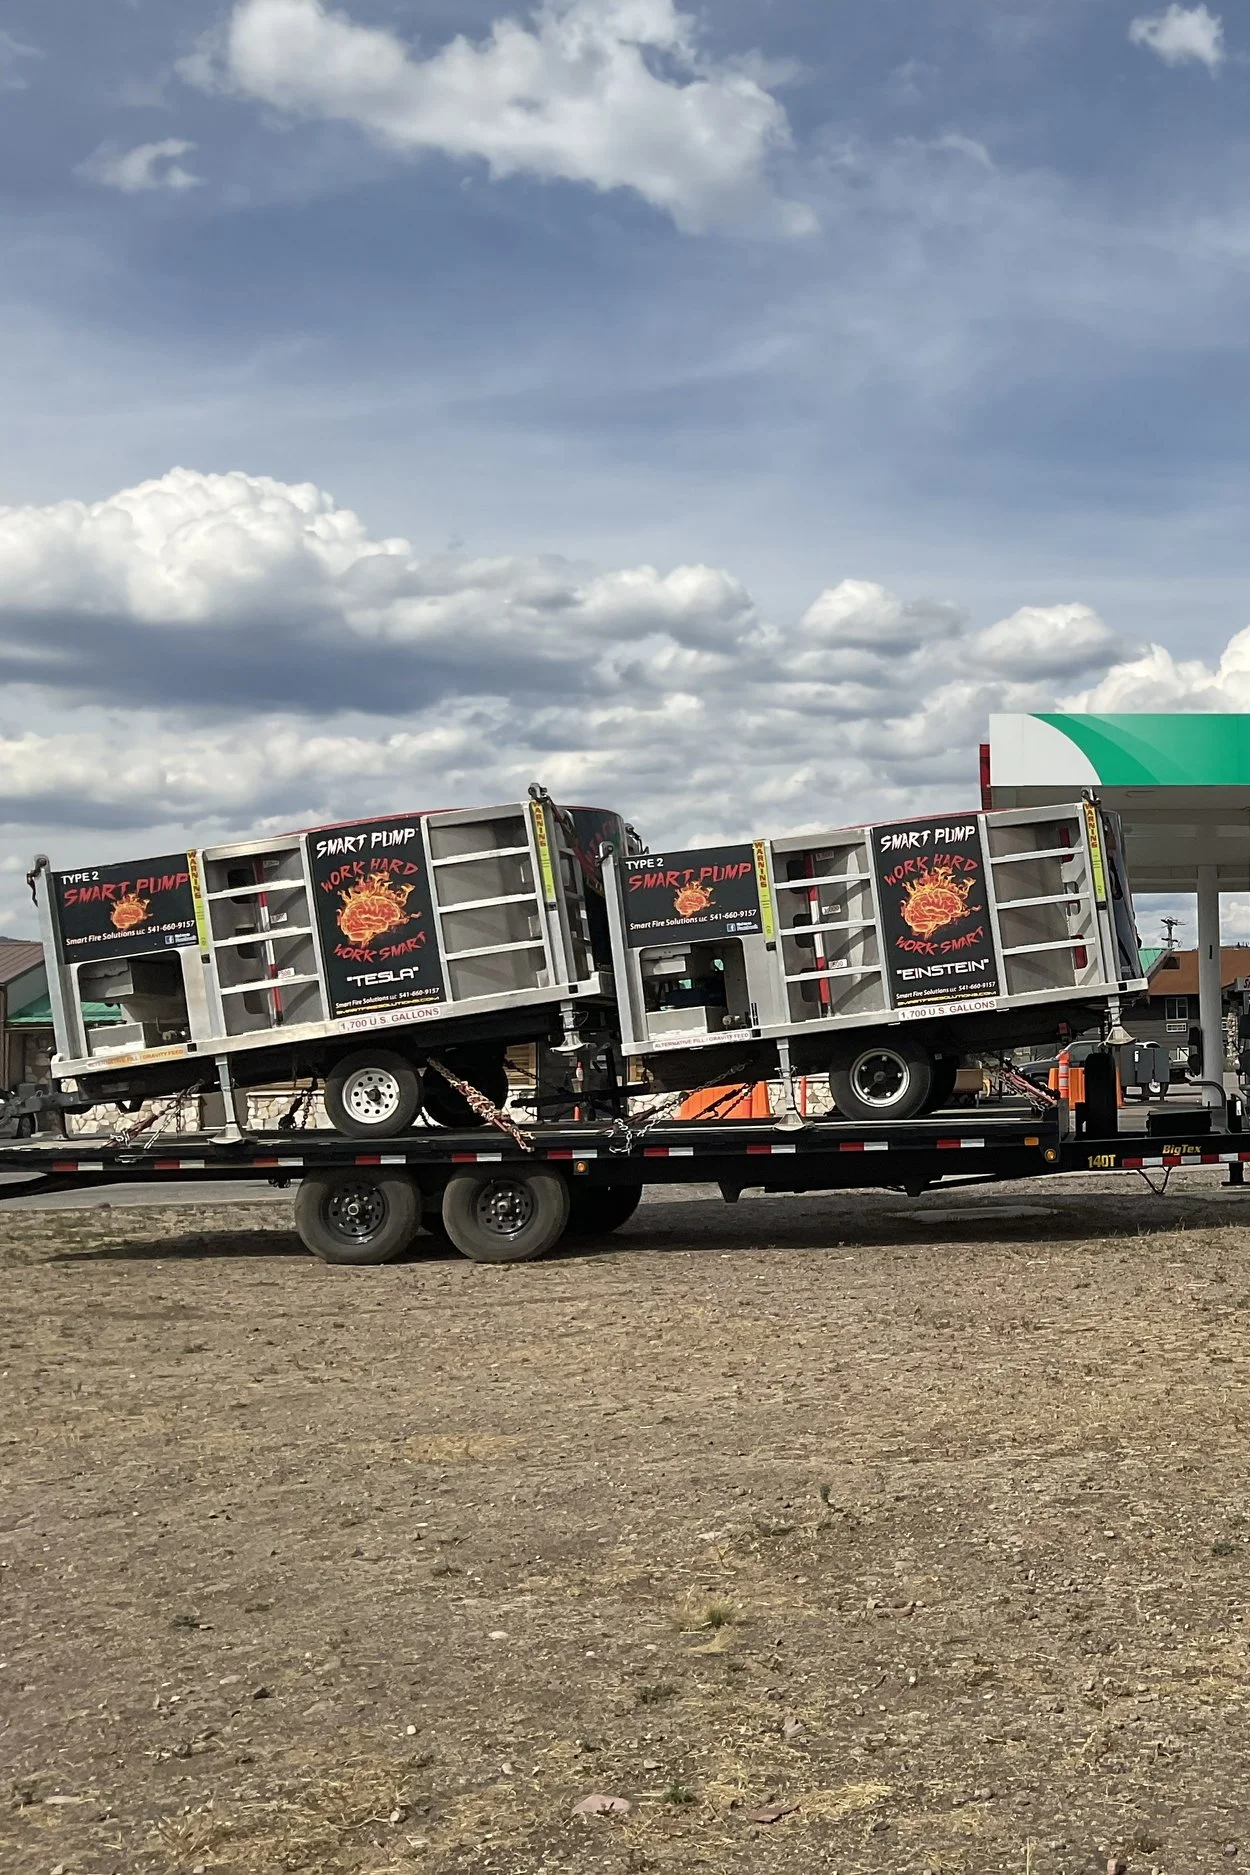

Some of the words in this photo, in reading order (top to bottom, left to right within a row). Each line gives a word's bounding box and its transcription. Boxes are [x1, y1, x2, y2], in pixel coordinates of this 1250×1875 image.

[880, 830, 931, 853] SMART
[934, 825, 976, 844] PUMP
[1084, 803, 1098, 848] WARNING
[316, 834, 367, 859] SMART
[371, 828, 415, 848] PUMP
[61, 872, 90, 885] TYPE
[91, 871, 99, 880] 2
[187, 850, 202, 899] WARNING
[321, 861, 365, 893] WORK
[370, 858, 418, 875] HARD
[625, 859, 655, 870] TYPE
[656, 858, 664, 867] 2
[628, 869, 695, 893] SMART
[699, 862, 752, 884] PUMP
[754, 842, 768, 888] WARNING
[884, 856, 928, 886] WORK
[933, 853, 978, 872] HARD
[64, 881, 131, 908] SMART
[136, 872, 190, 895] PUMP
[66, 936, 87, 946] Smart
[88, 934, 102, 943] Fire
[102, 929, 135, 941] Solutions
[147, 920, 195, 934] 541-660-9157
[630, 922, 651, 930] Smart
[652, 919, 665, 927] Fire
[666, 915, 698, 926] Solutions
[709, 909, 757, 922] 541-660-9157
[333, 944, 377, 963] WORK
[379, 931, 426, 961] SMART
[895, 936, 939, 956] WORK
[940, 926, 984, 954] SMART
[335, 1001, 352, 1009] Smart
[363, 995, 389, 1005] Solutions
[399, 988, 439, 999] 541-660-9157
[896, 992, 912, 1000] Smart
[913, 990, 923, 998] Fire
[924, 987, 949, 996] Solutions
[958, 981, 996, 992] 541-660-9157
[341, 1020, 367, 1031] 1,700
[392, 1008, 439, 1022] GALLONS
[901, 1010, 926, 1020] 1,700
[949, 1001, 995, 1013] GALLONS
